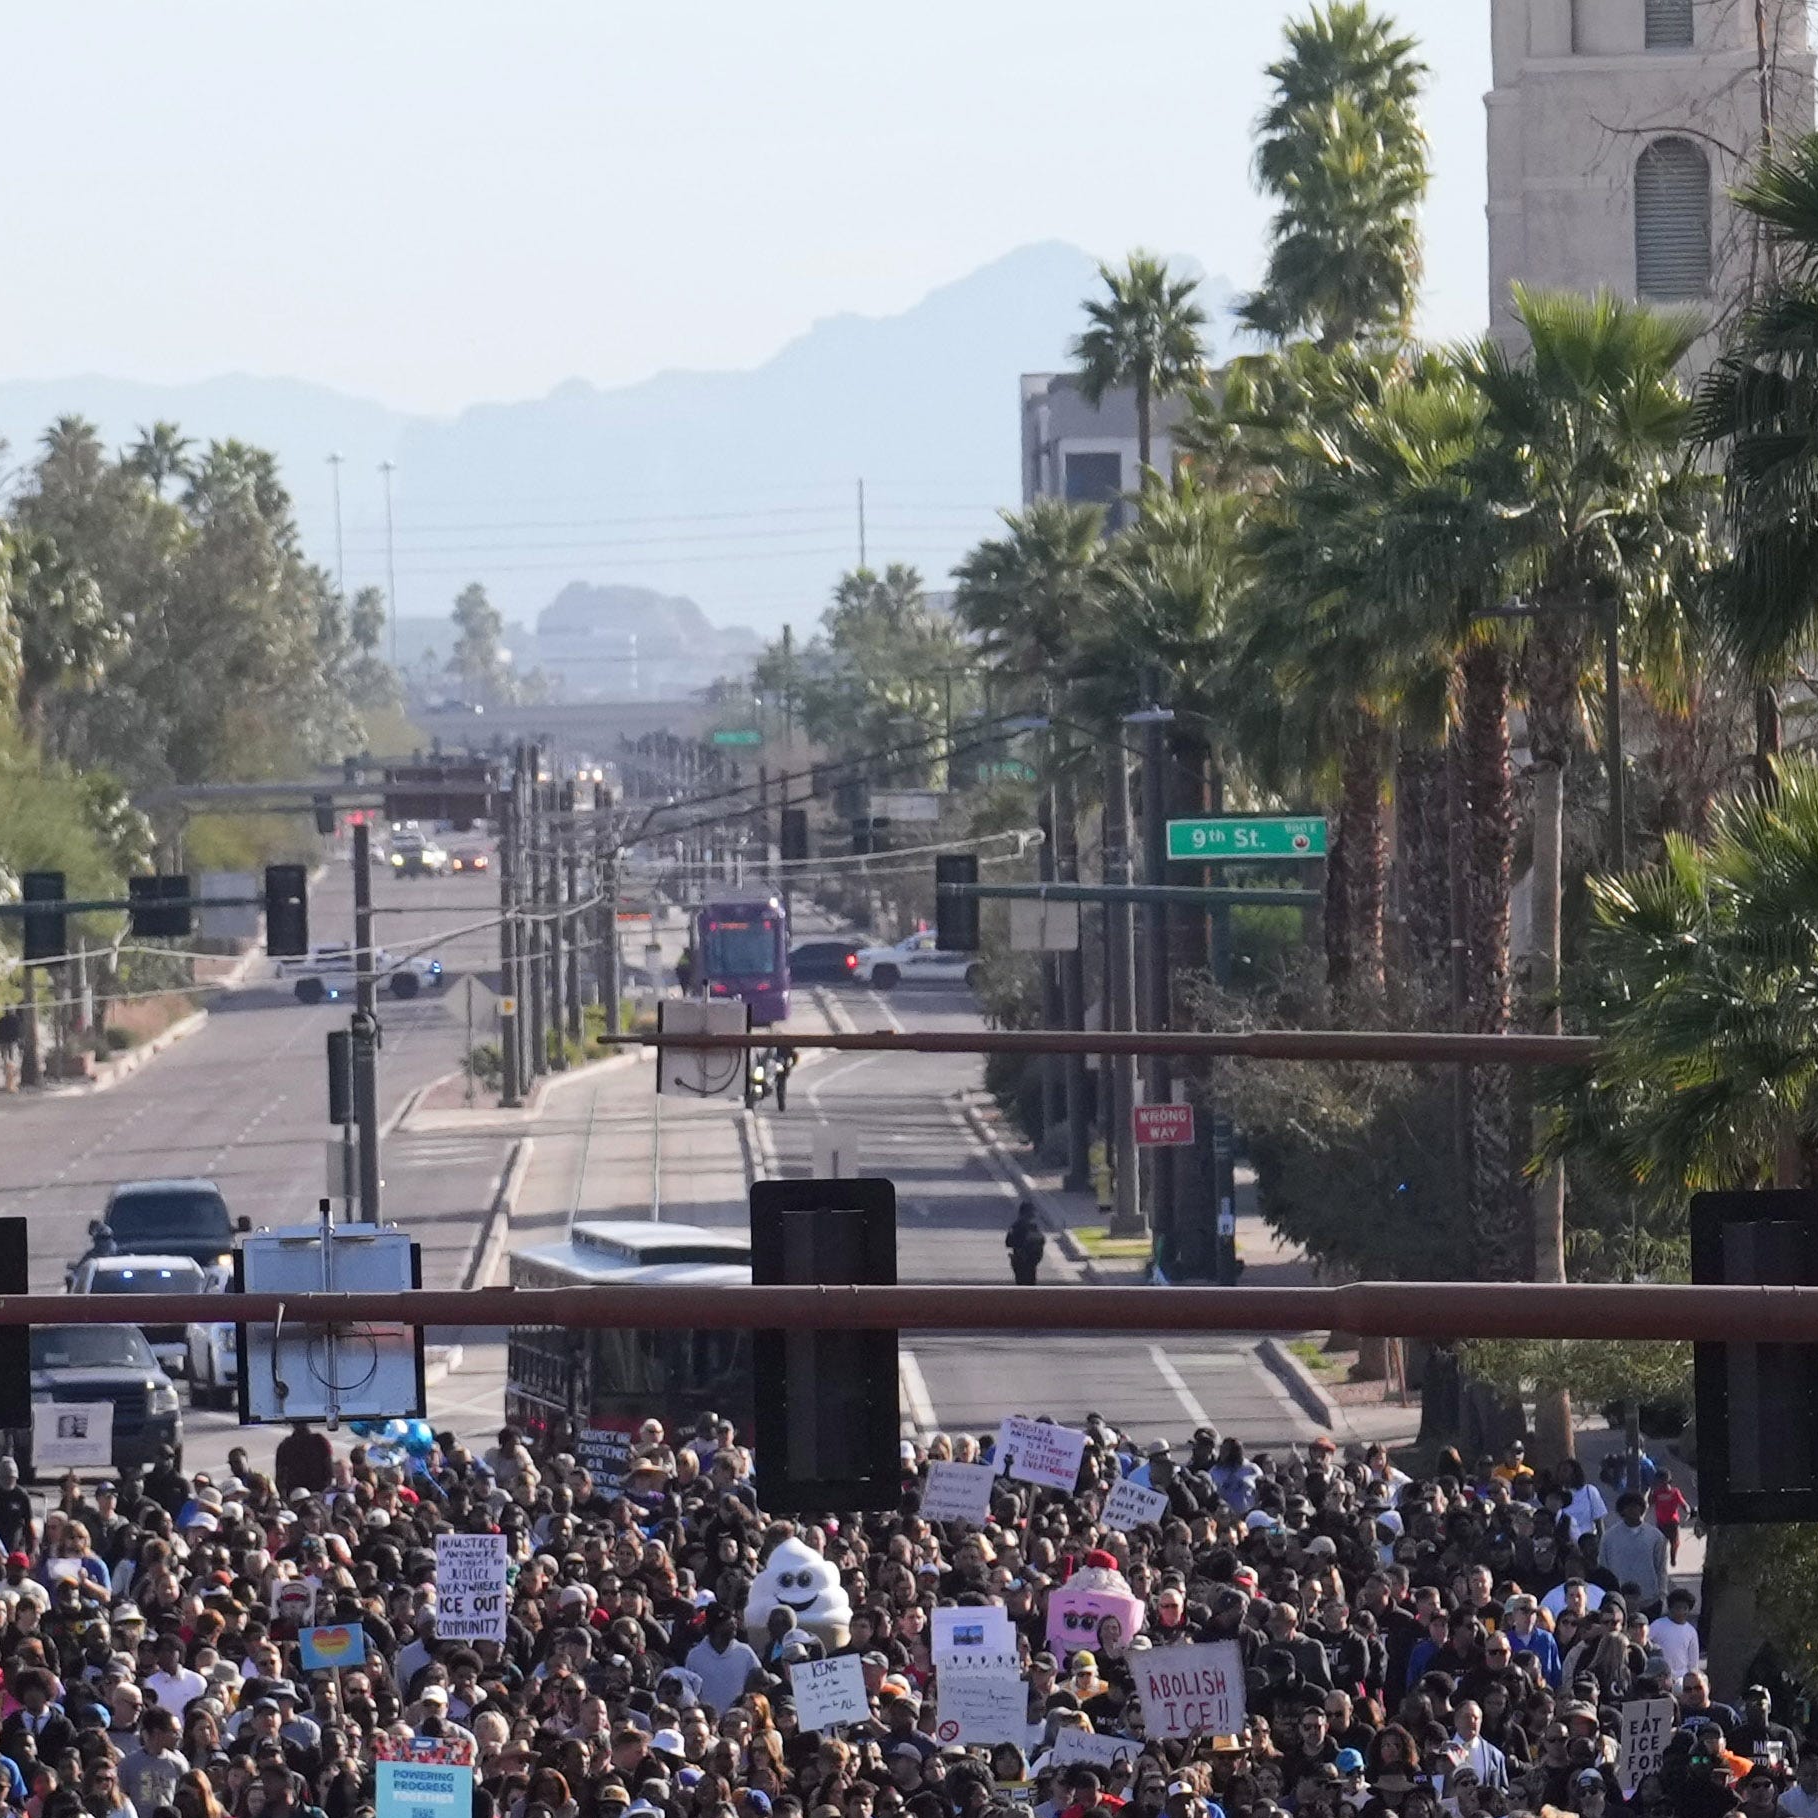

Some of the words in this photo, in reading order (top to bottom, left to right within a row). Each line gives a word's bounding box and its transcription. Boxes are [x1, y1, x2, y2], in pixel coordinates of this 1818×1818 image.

[1191, 829, 1226, 848] 9th
[1234, 828, 1266, 847] St.
[1139, 1108, 1187, 1123] WRONG
[1150, 1125, 1178, 1139] WAY
[439, 1538, 499, 1551] INJUSTICE
[440, 1597, 463, 1613] ICE
[474, 1595, 501, 1612] OUT
[437, 1618, 500, 1636] COMMUNITY
[1149, 1670, 1227, 1700] ABOLISH
[1630, 1718, 1661, 1735] EAT
[1631, 1737, 1659, 1751] ICE
[1628, 1755, 1663, 1770] FOR
[393, 1770, 455, 1782] POWERING
[394, 1781, 454, 1792] PROGRESS
